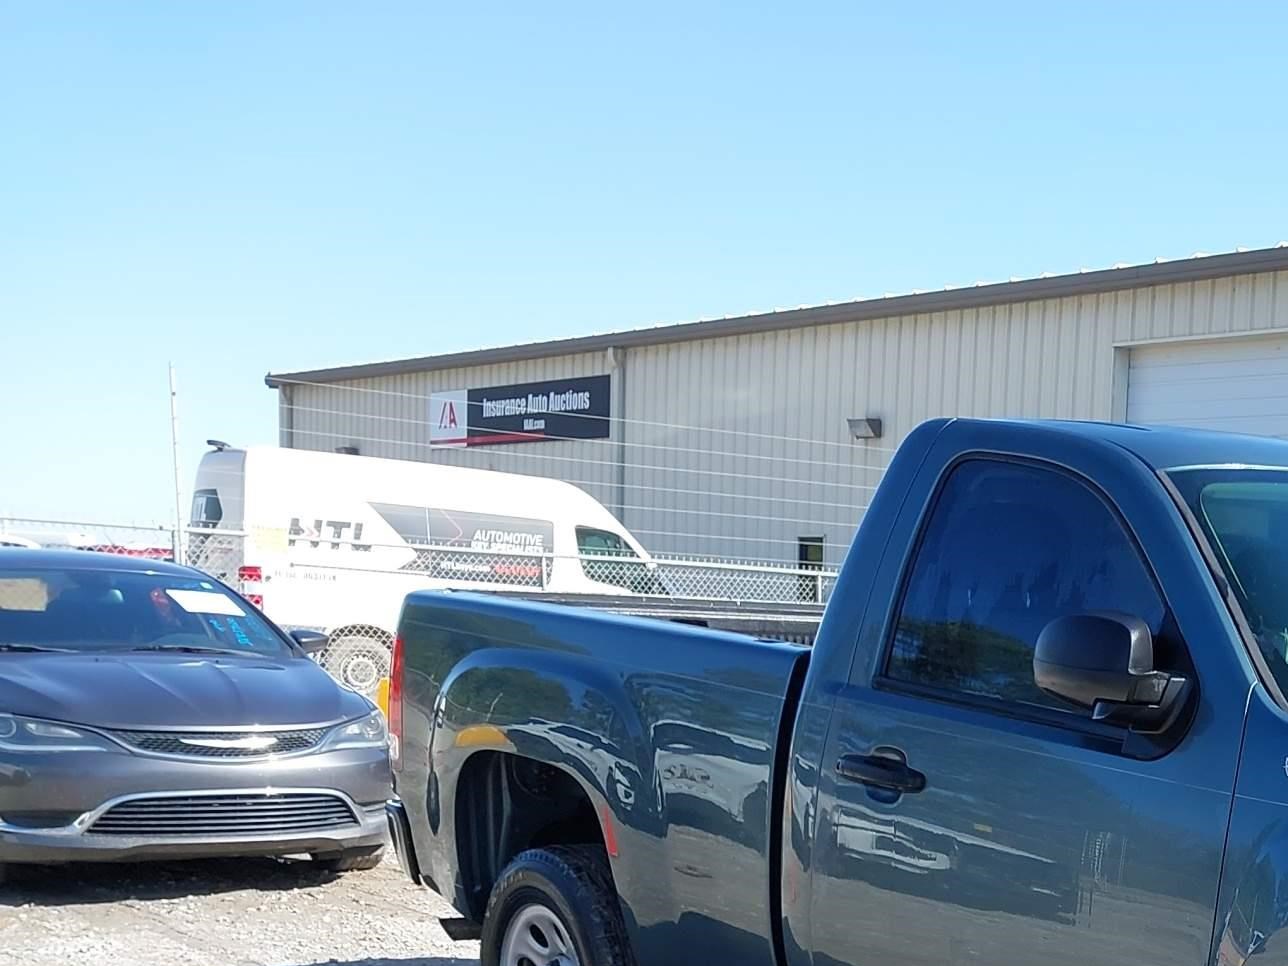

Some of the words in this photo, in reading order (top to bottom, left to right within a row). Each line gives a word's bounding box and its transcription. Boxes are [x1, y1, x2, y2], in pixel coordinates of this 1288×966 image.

[482, 396, 527, 418] Insurance
[527, 393, 549, 413] Auto
[549, 389, 590, 412] Auctions
[473, 529, 544, 546] AUTOMOTIVE
